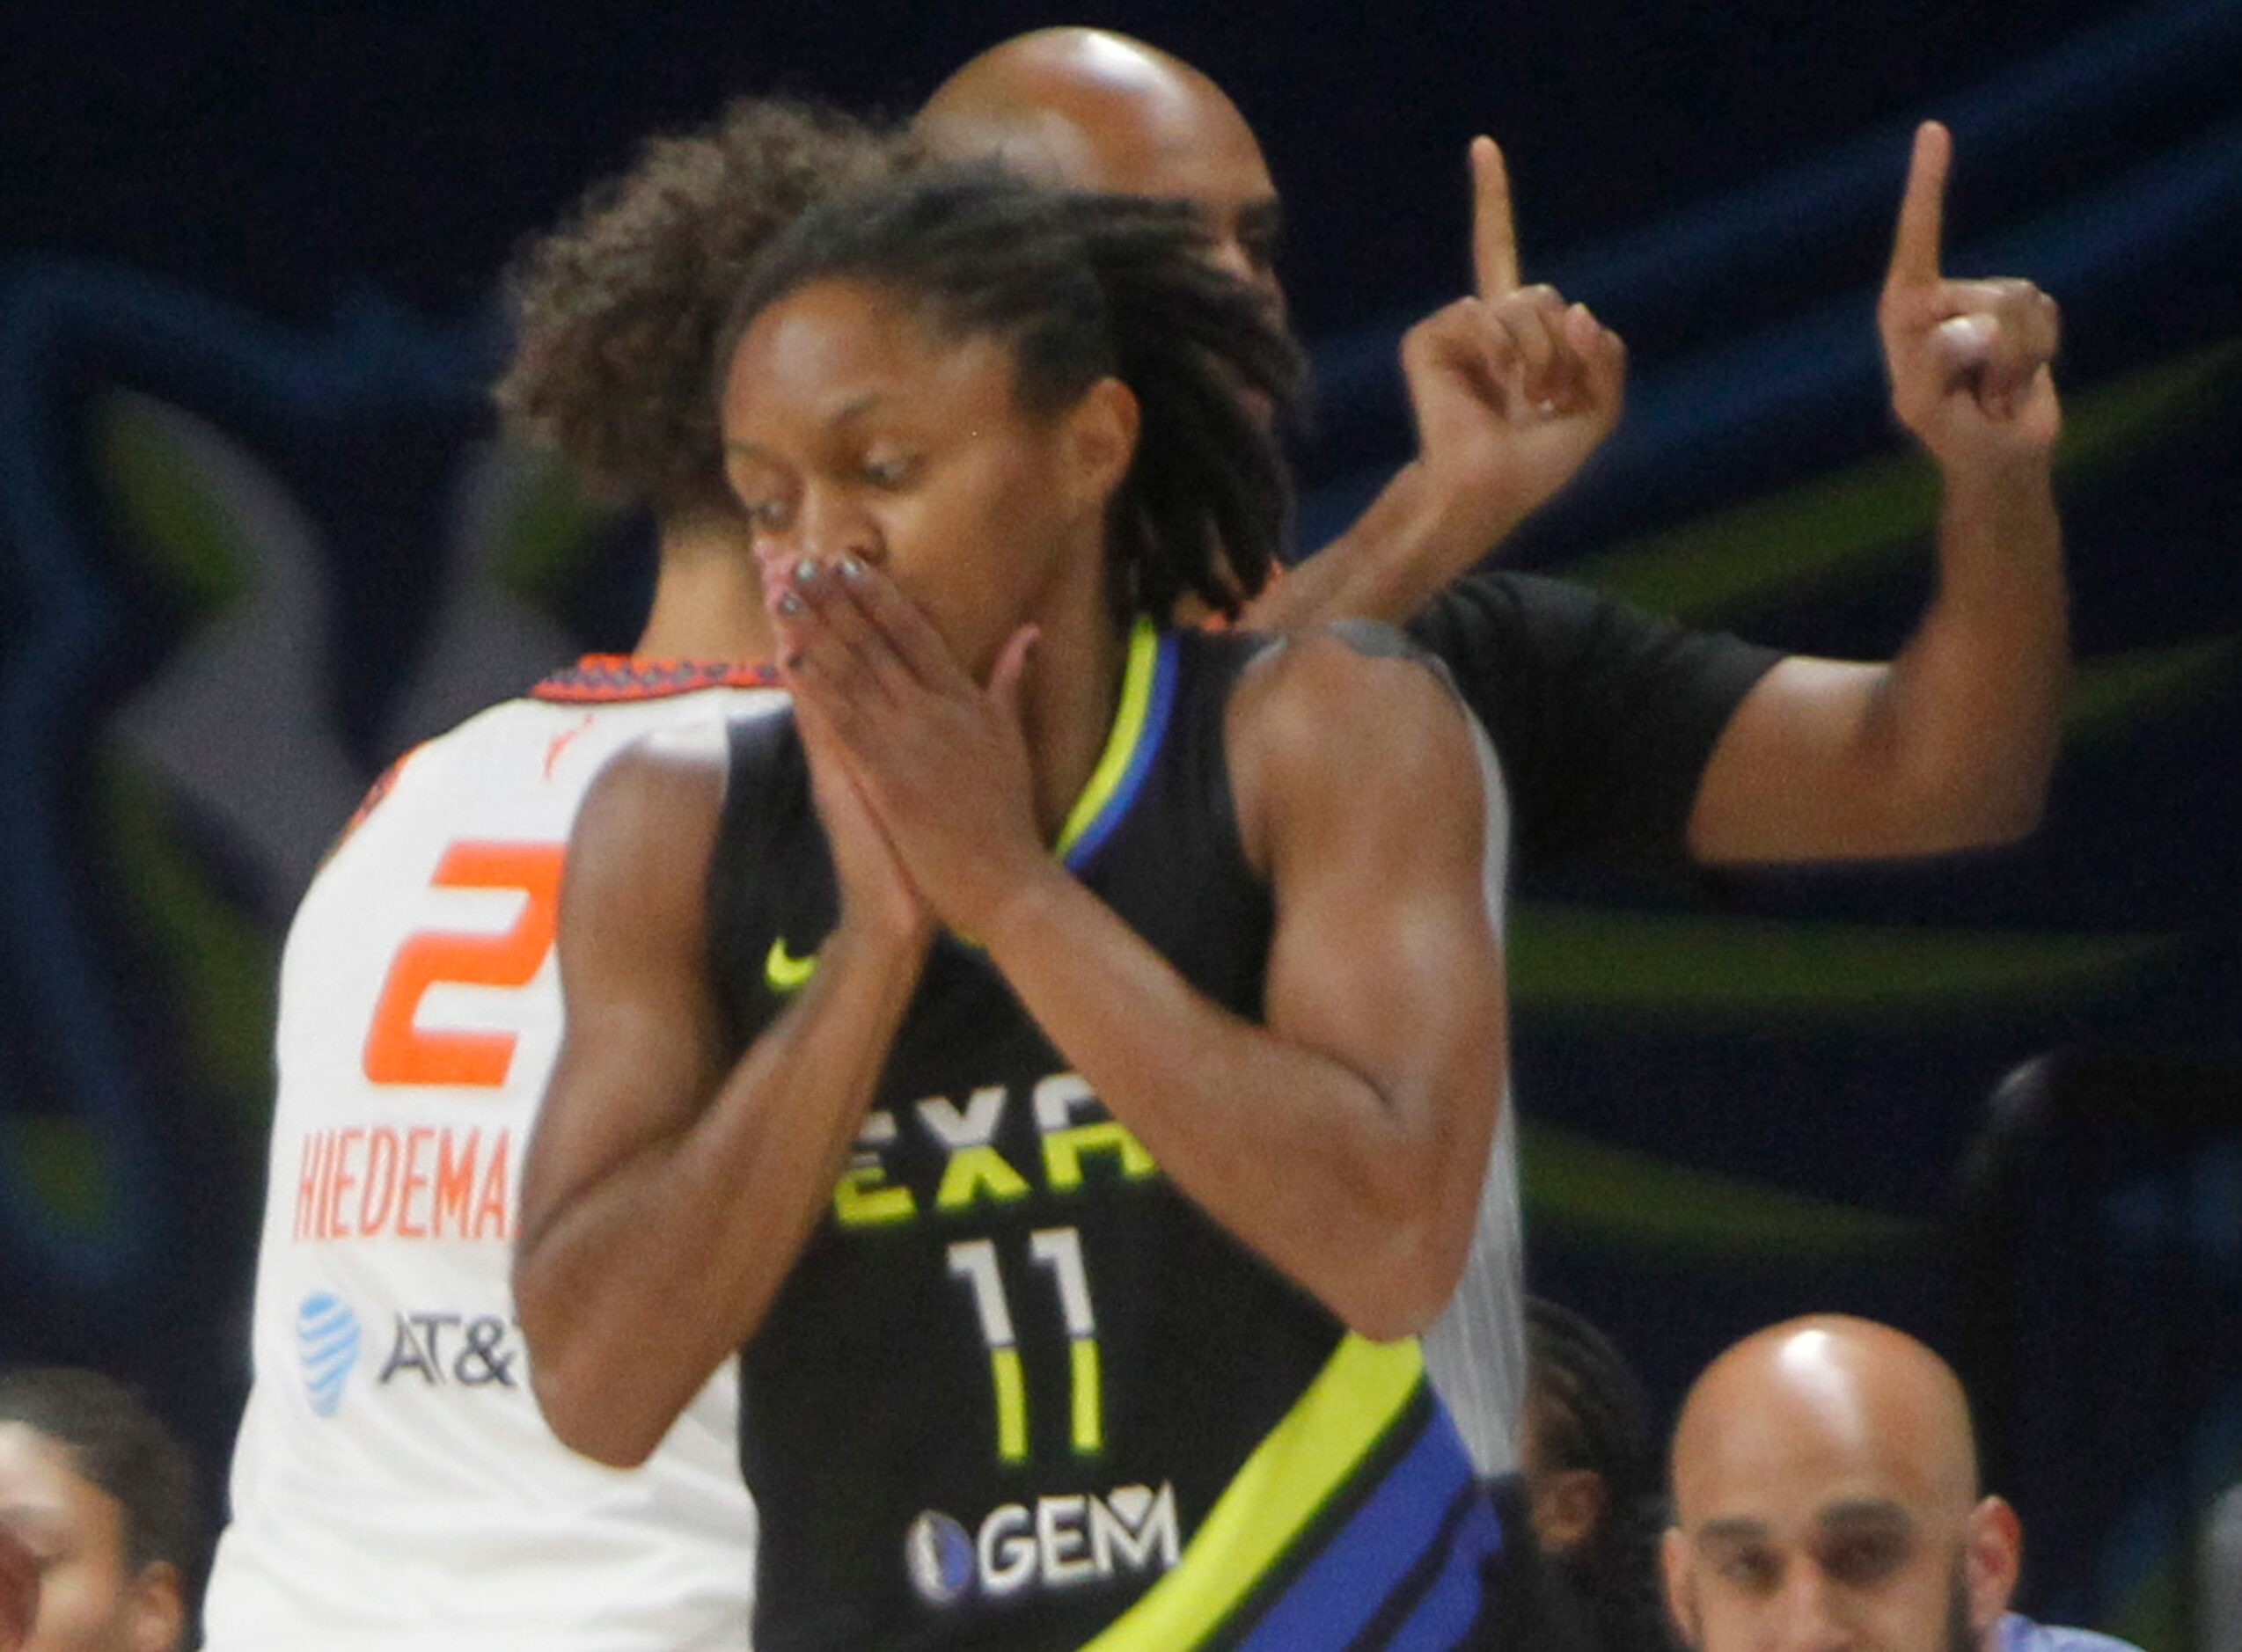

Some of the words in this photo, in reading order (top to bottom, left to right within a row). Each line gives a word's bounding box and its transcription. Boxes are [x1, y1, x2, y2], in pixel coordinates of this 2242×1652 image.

[363, 838, 570, 1088] 2
[291, 1125, 524, 1242] HIEDEMA
[378, 1311, 521, 1387] AT&
[947, 1226, 1103, 1465] 11
[976, 1480, 1182, 1597] GEM
